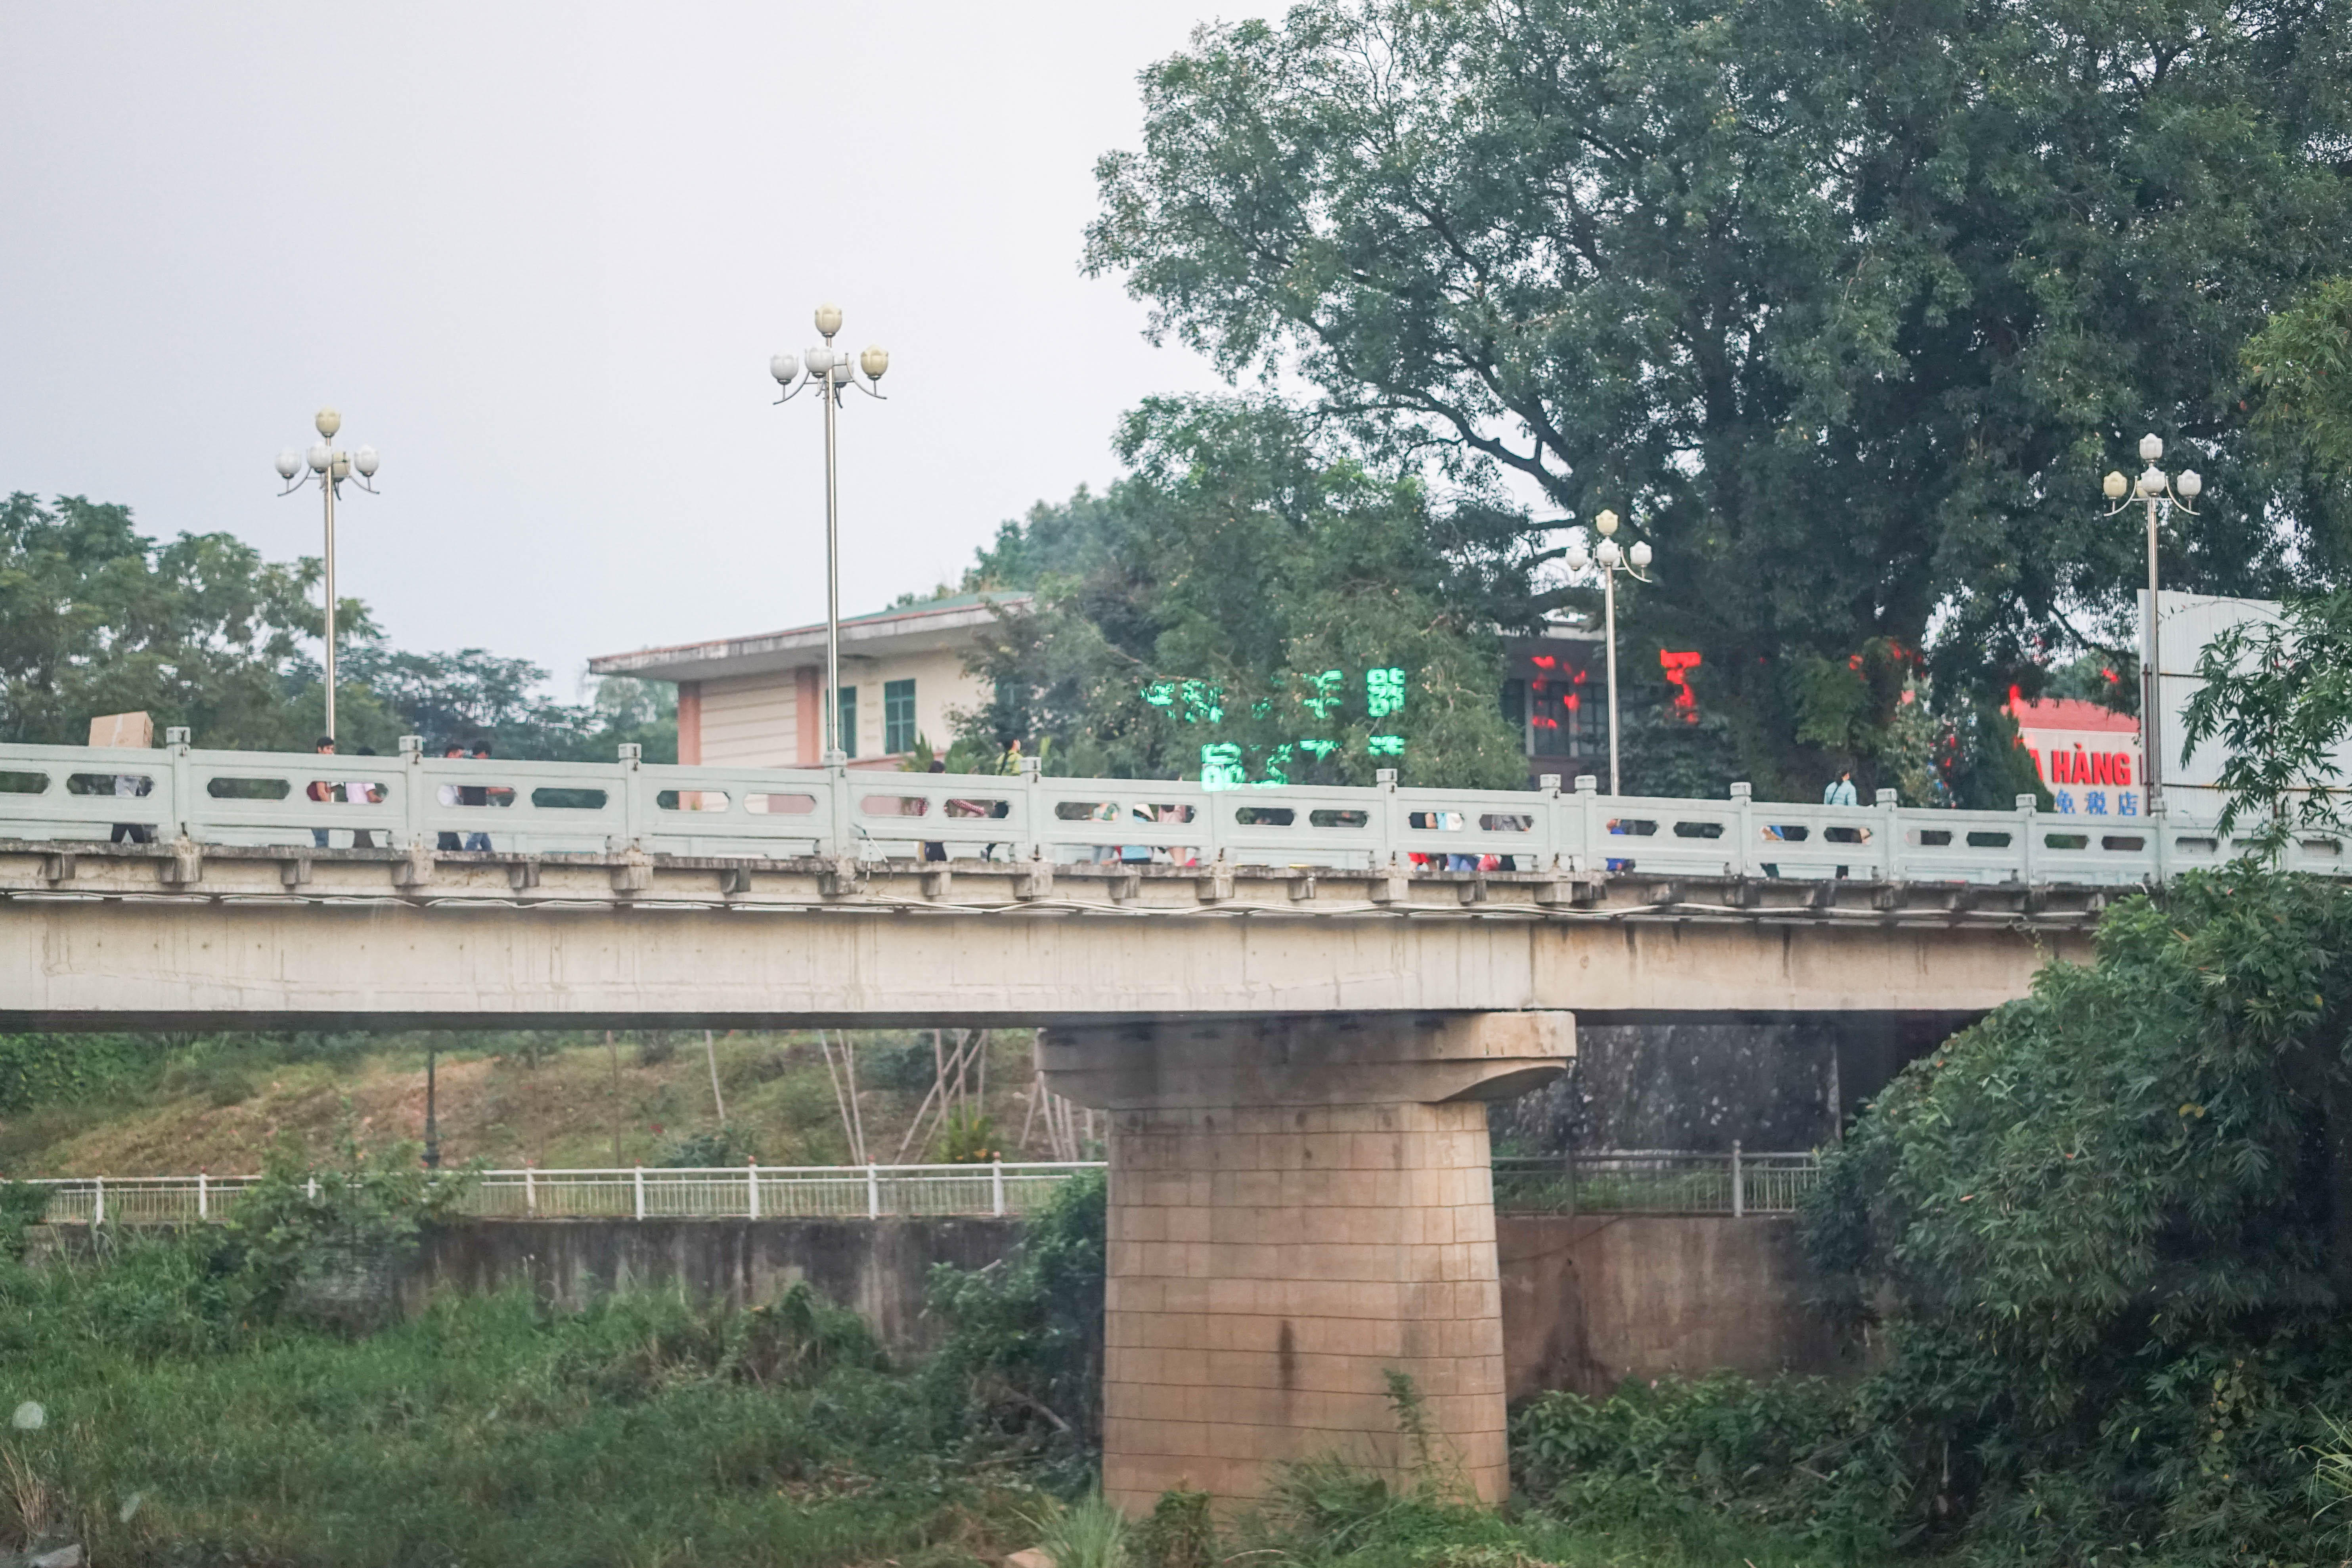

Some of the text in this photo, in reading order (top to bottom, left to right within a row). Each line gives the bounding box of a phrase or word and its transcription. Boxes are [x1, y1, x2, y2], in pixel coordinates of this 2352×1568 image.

[2052, 742, 2131, 785] HÀNG
[2055, 789, 2138, 816] 免税店
